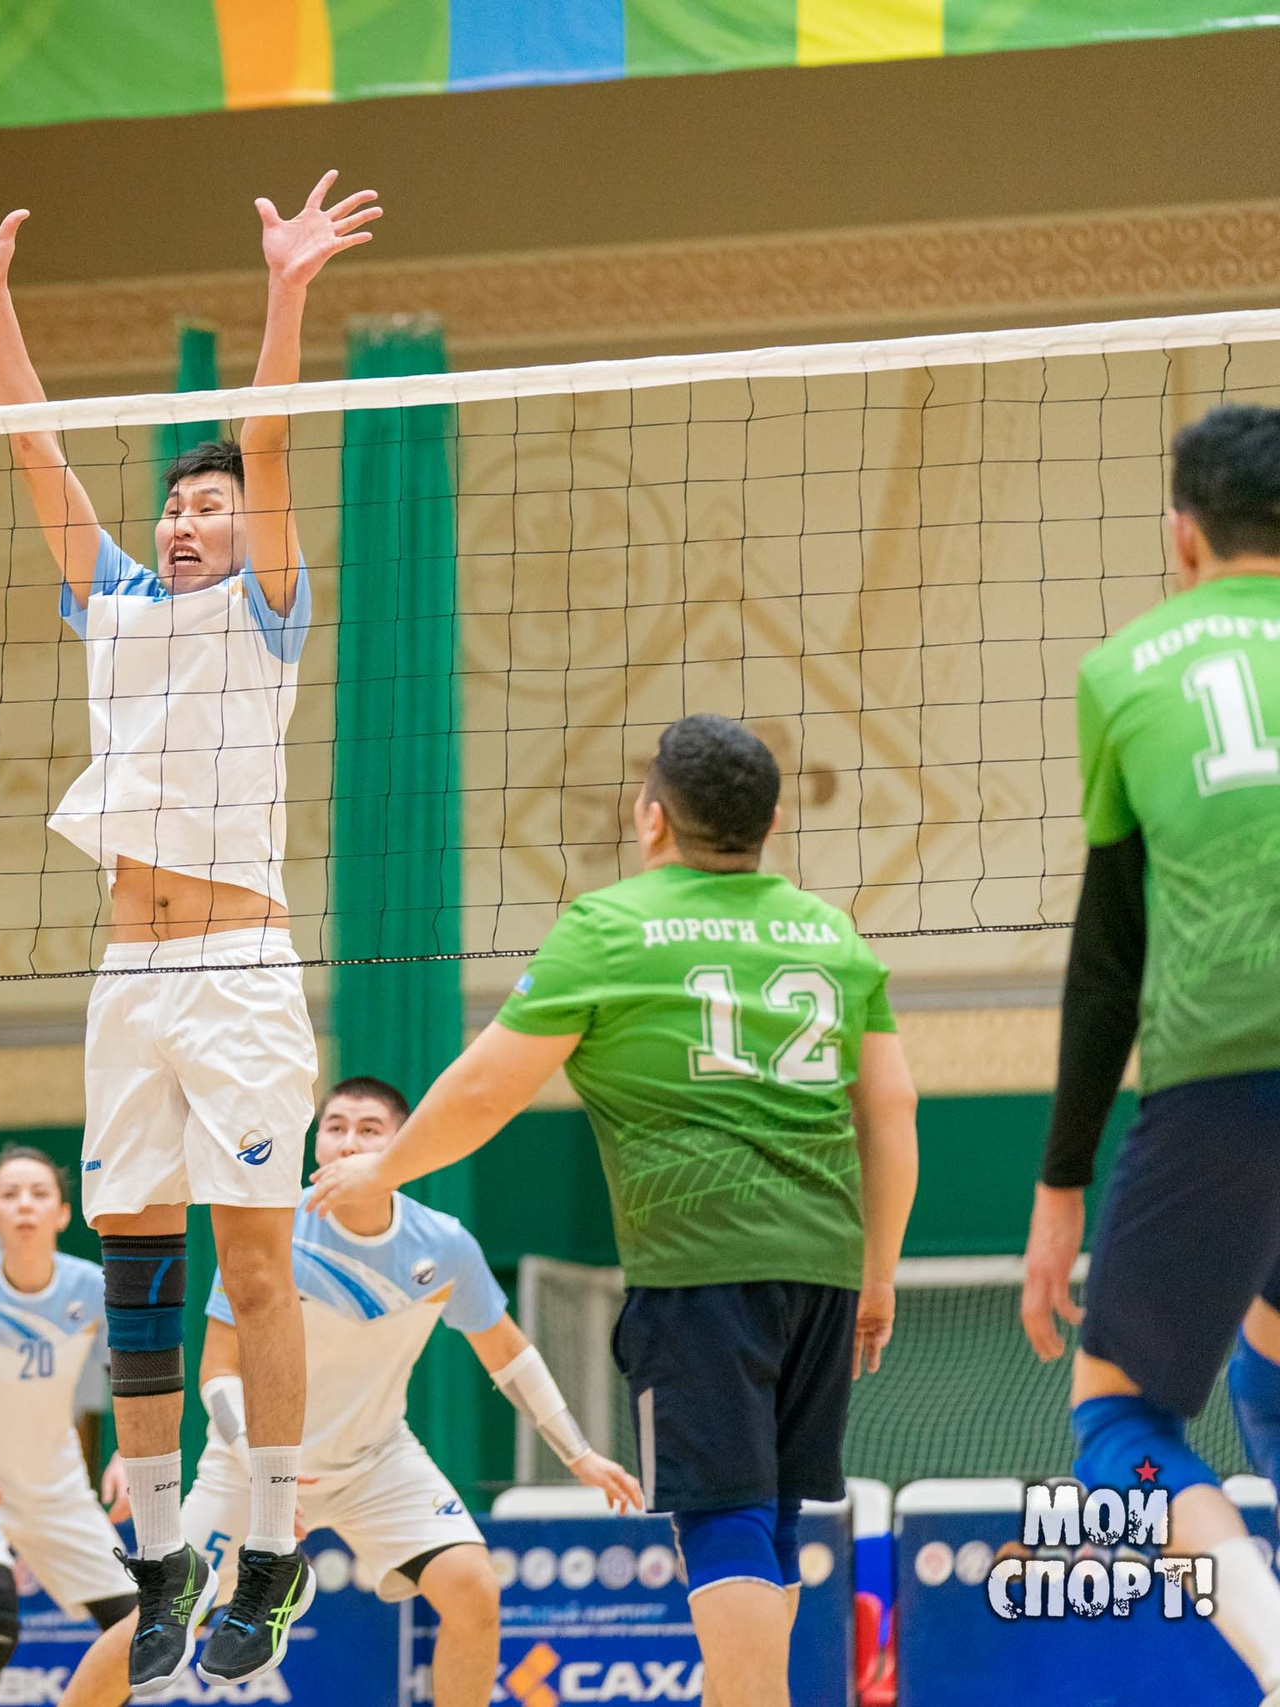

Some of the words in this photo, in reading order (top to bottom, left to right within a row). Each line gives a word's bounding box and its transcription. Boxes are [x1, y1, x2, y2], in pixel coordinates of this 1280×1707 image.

[641, 917, 759, 948] ДОРОГИ
[768, 919, 841, 945] САХА
[684, 963, 845, 1091] 12
[19, 1340, 55, 1380] 20
[204, 1530, 232, 1571] 5
